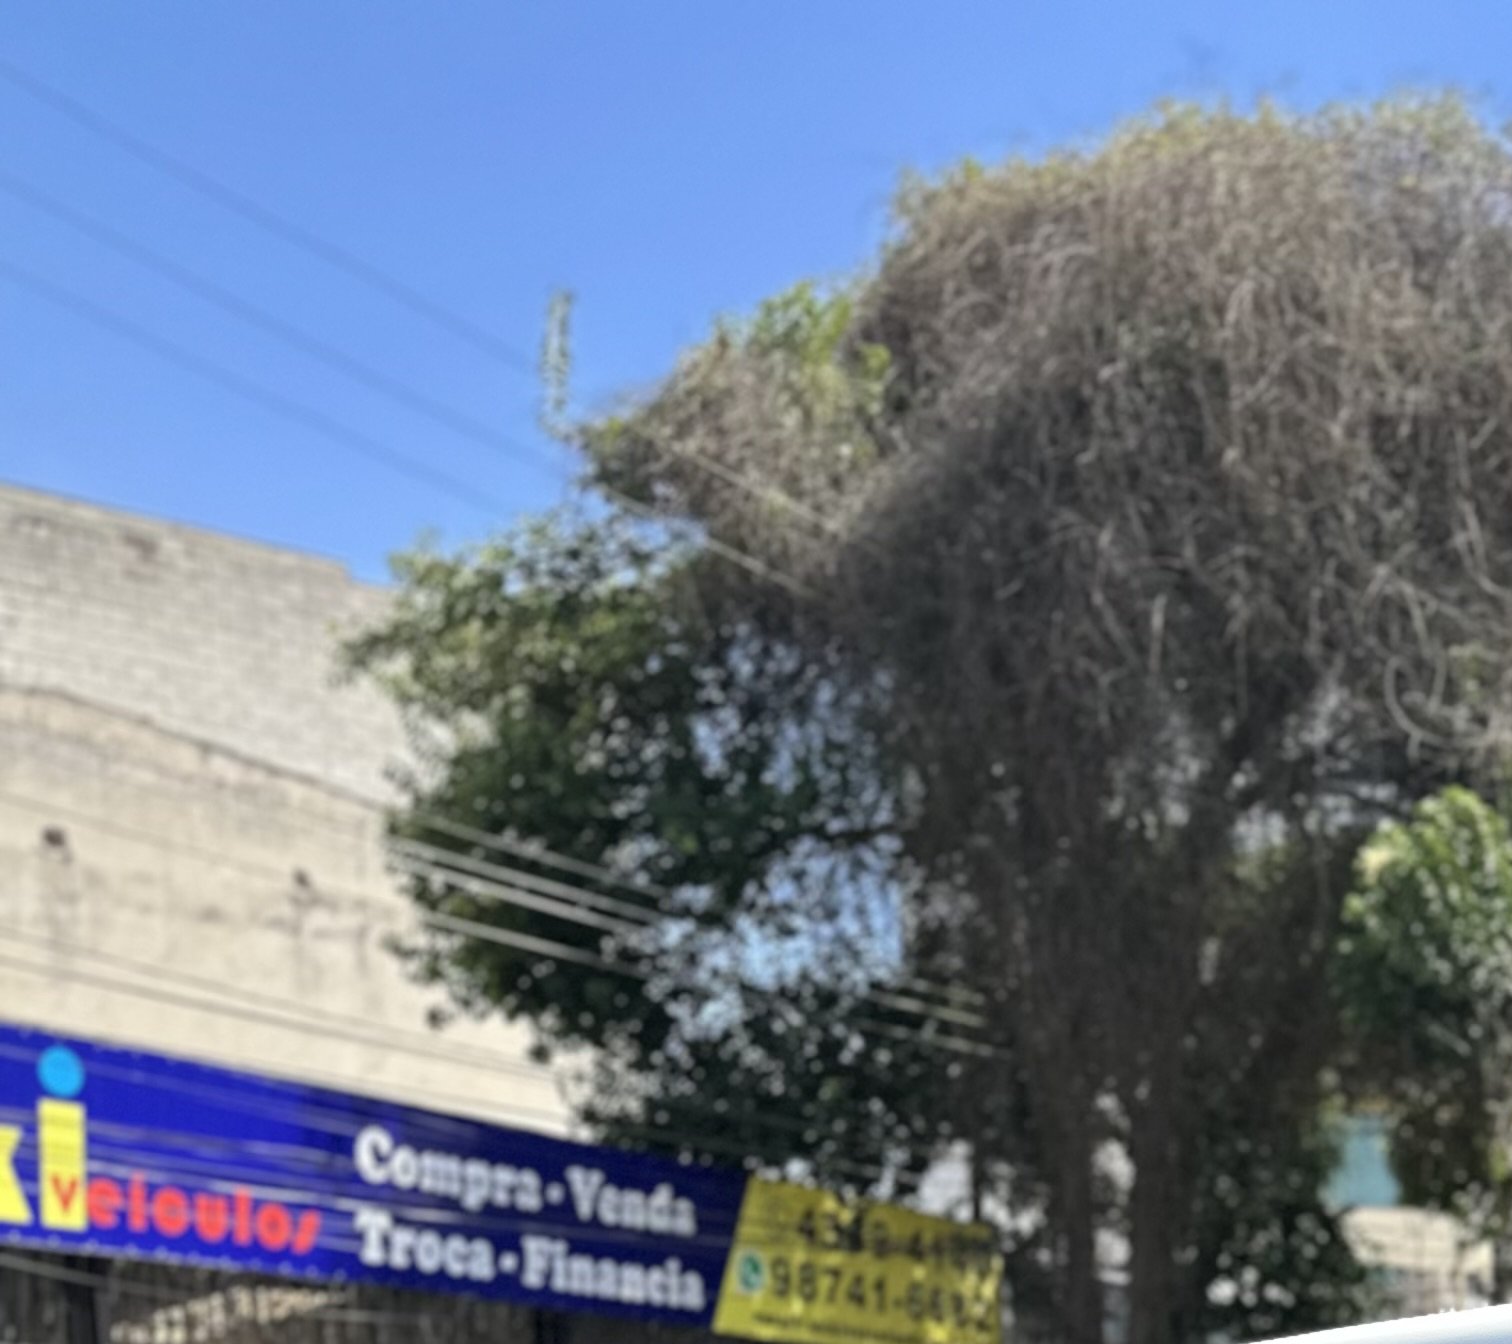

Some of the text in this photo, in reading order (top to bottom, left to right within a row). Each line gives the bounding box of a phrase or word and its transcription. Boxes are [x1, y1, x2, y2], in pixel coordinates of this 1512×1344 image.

[355, 1126, 697, 1236] Compra Venda
[354, 1209, 495, 1282] Troca
[522, 1235, 706, 1310] Financia
